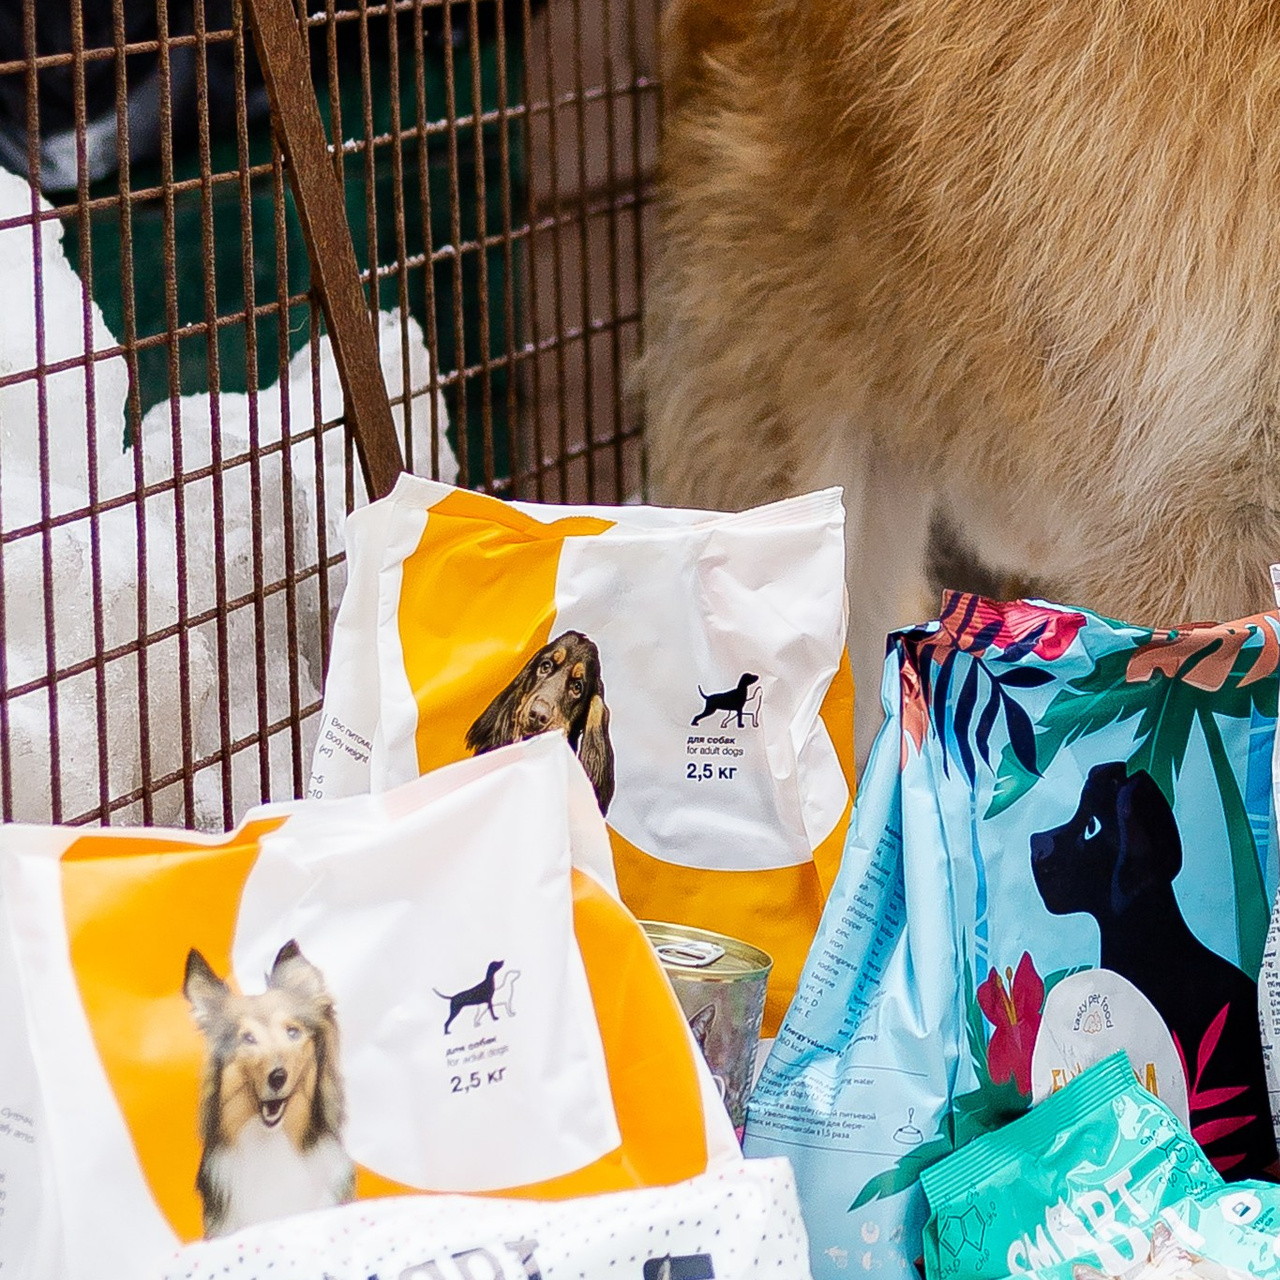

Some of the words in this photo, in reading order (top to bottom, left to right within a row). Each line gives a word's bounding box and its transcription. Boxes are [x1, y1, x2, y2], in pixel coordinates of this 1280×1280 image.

[687, 736, 705, 745] для
[706, 735, 736, 744] собак
[687, 746, 698, 755] for
[700, 745, 720, 756] adult
[722, 746, 744, 758] dogs
[686, 762, 714, 782] 2,5
[718, 767, 738, 780] кг
[450, 1071, 482, 1094] 2,5
[487, 1066, 507, 1085] кг
